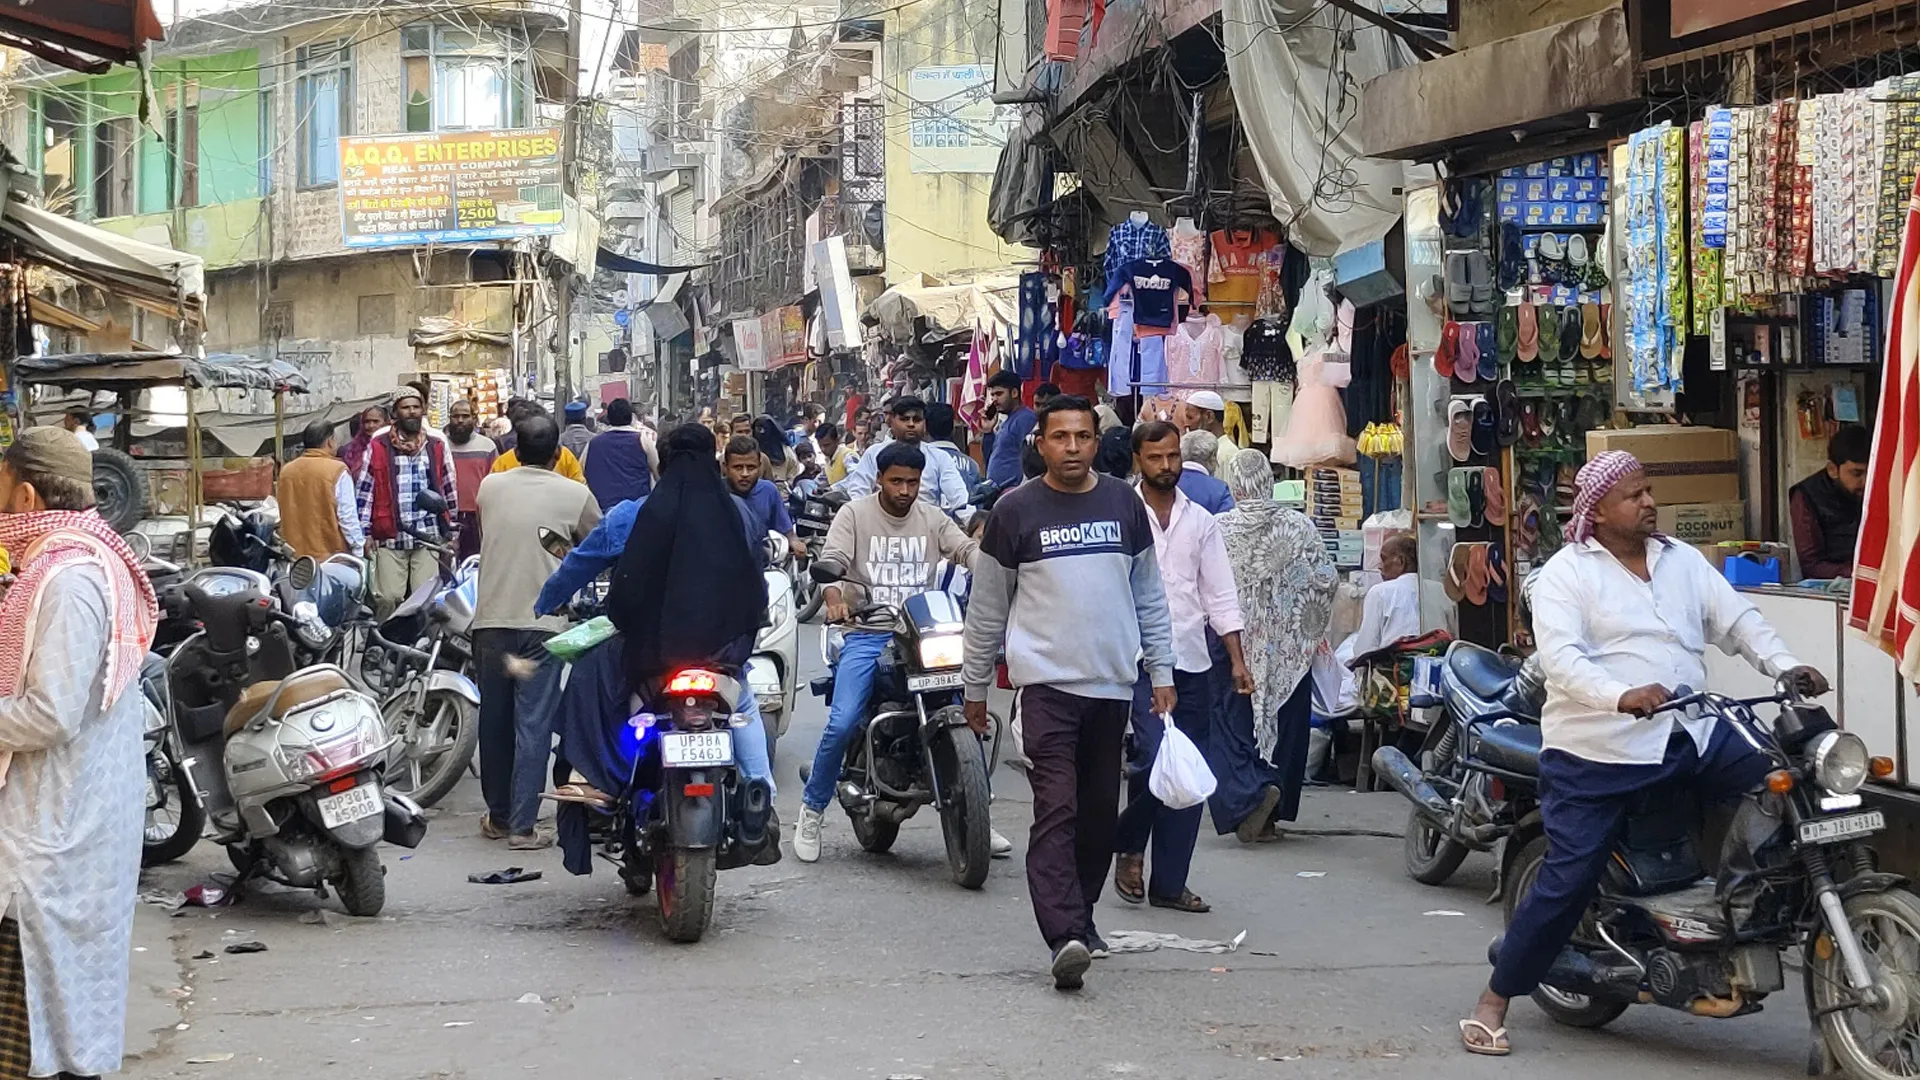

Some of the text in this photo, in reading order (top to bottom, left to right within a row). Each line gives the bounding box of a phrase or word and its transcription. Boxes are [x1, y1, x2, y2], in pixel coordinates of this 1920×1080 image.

[414, 137, 557, 163] ENTERPRISES
[382, 159, 519, 174] REAL STATE COMPANY
[458, 208, 496, 220] 2500
[1039, 522, 1121, 544] BROOKLYN
[1676, 521, 1735, 531] COCONUT
[869, 535, 927, 563] NEW
[865, 562, 930, 586] YORK
[872, 586, 924, 607] CIT
[680, 735, 721, 747] UP38A
[681, 748, 723, 761] F5463
[330, 789, 370, 810] UP38A
[335, 801, 376, 823] A5808
